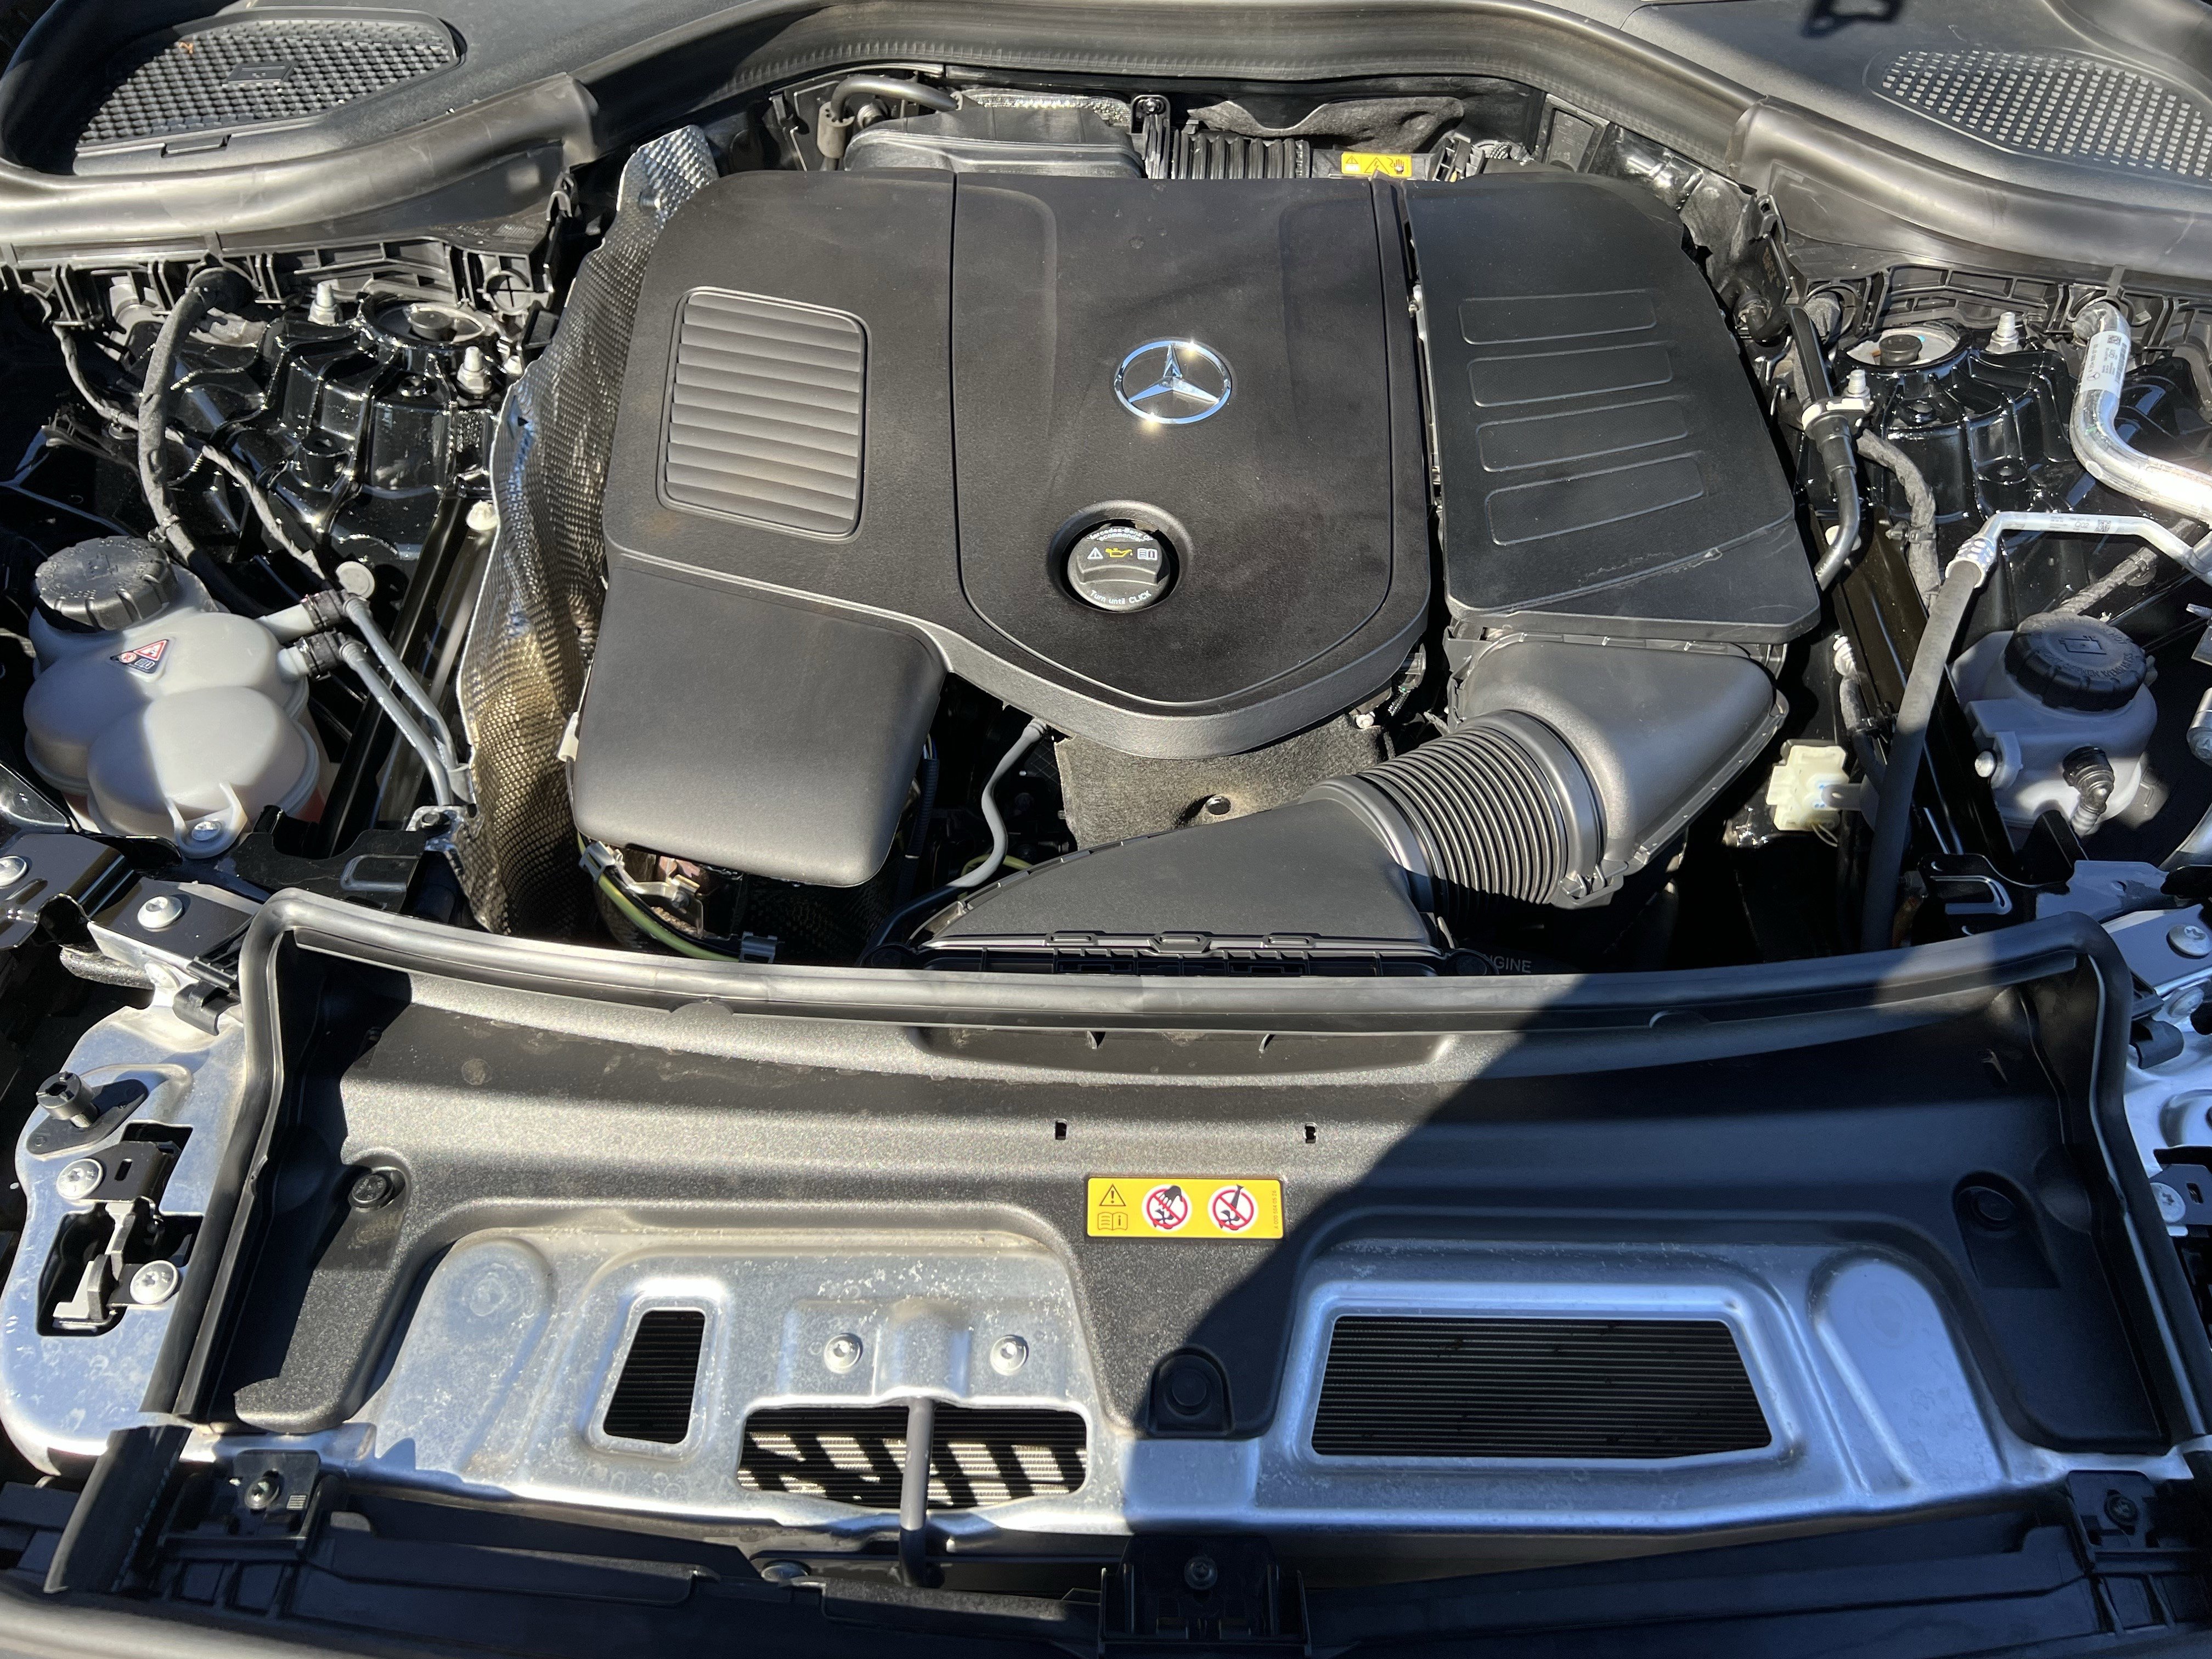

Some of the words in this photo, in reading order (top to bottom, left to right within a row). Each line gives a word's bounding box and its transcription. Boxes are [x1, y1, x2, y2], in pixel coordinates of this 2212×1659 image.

[1090, 590, 1106, 602] Turn
[1128, 590, 1152, 603] CLICK
[1490, 955, 1532, 974] GINE
